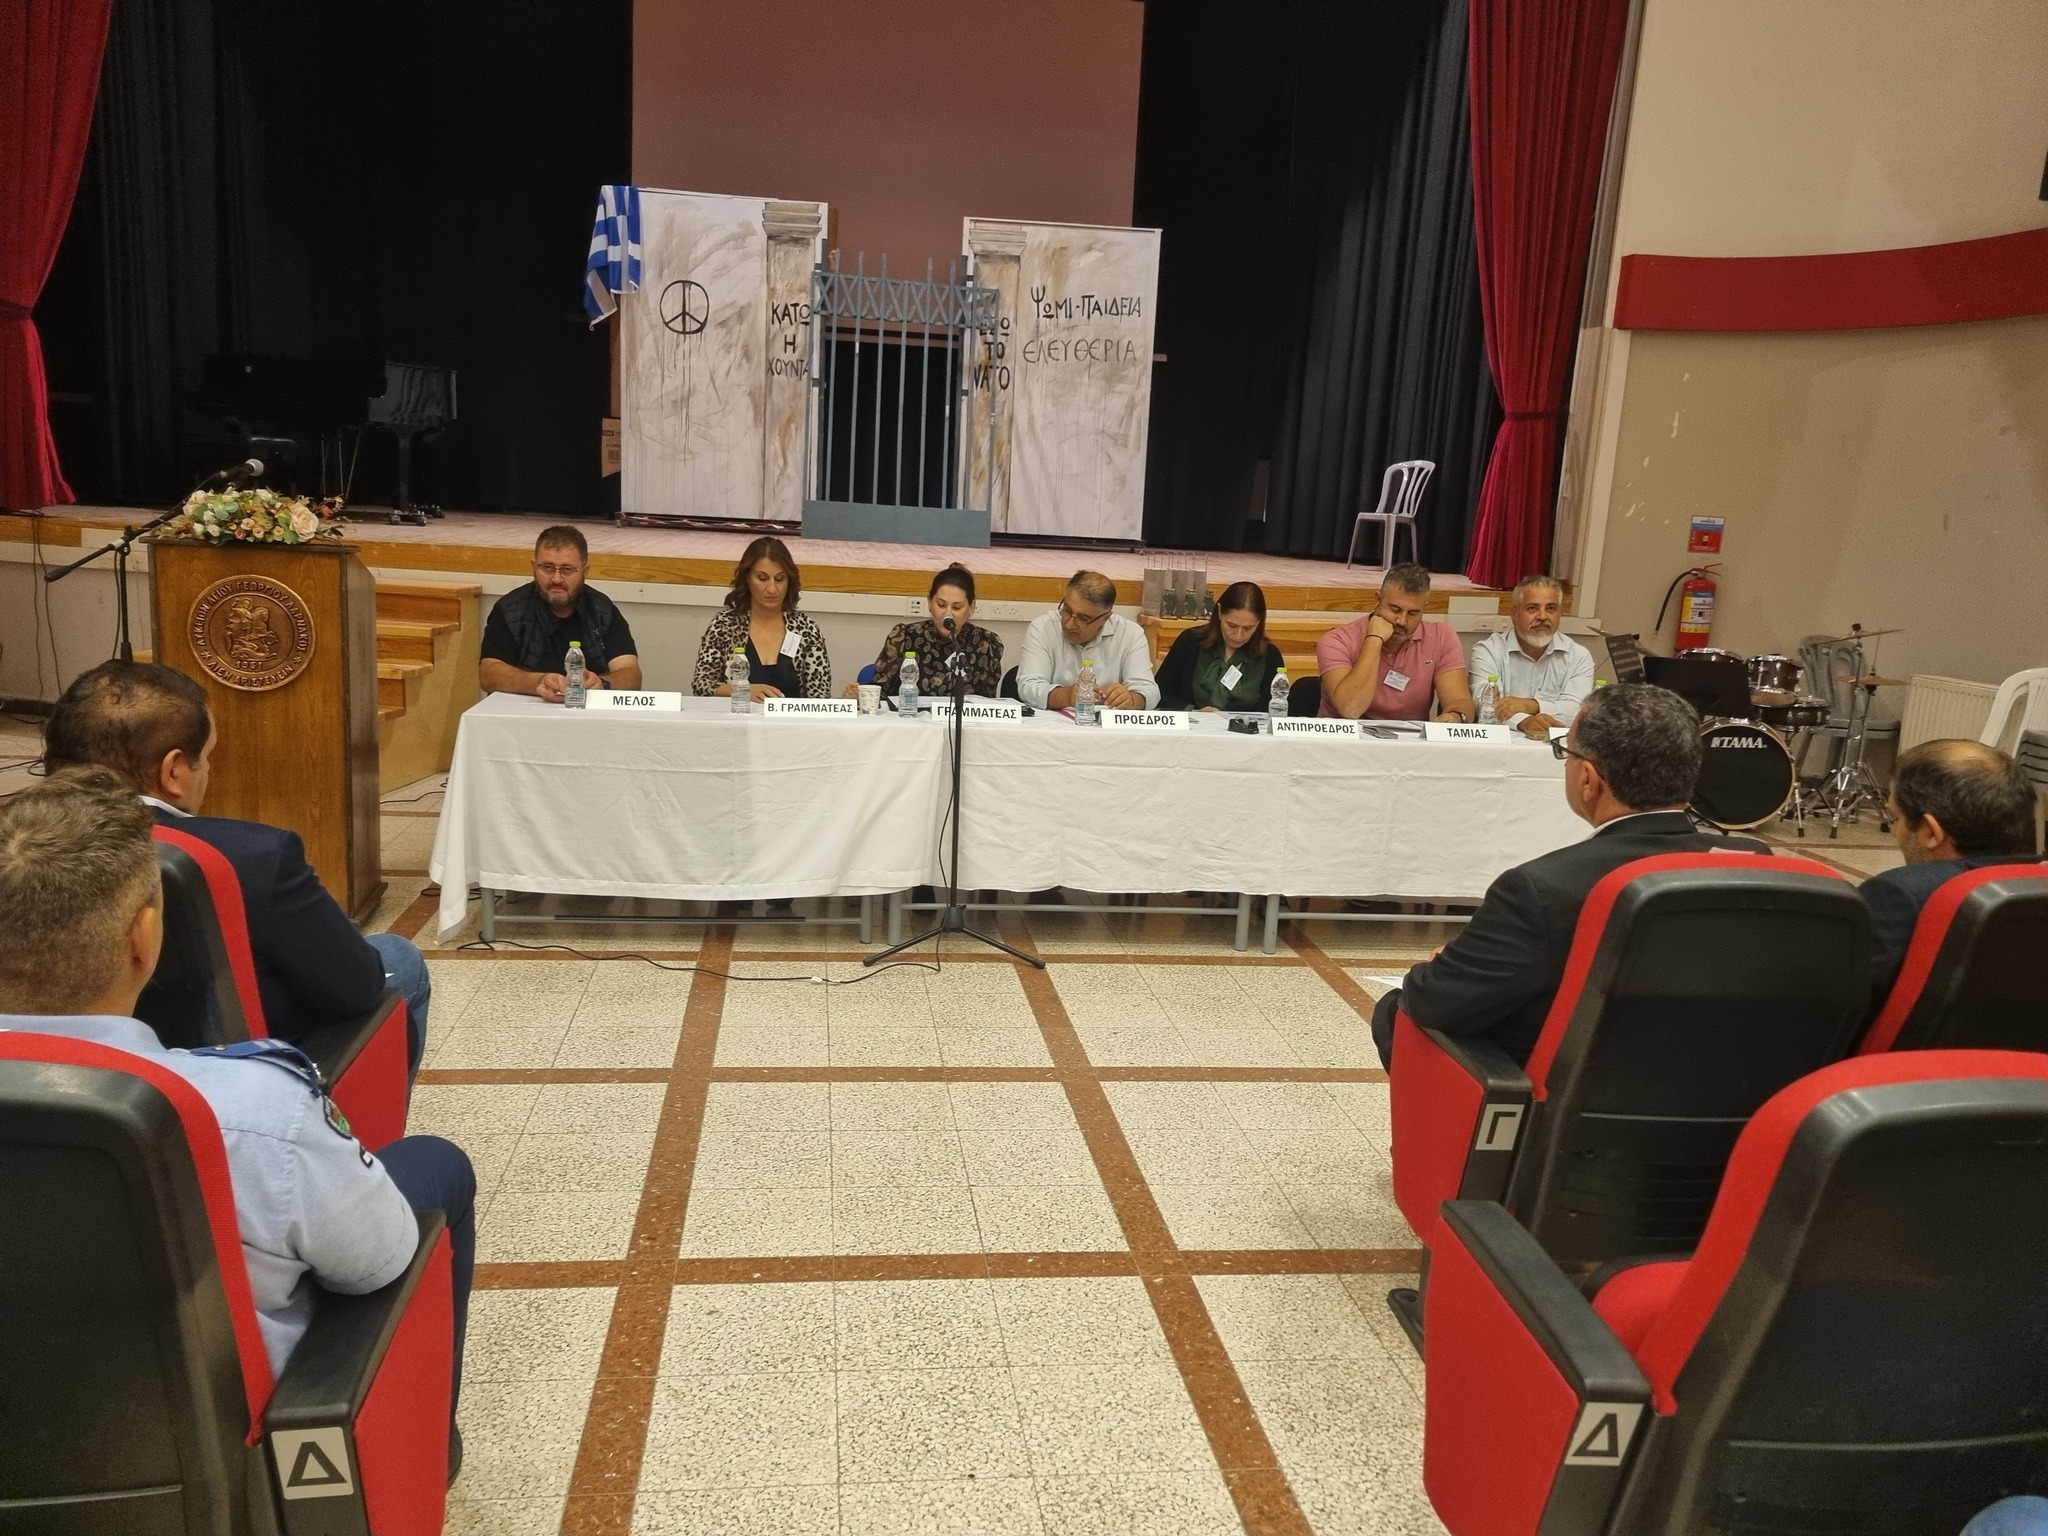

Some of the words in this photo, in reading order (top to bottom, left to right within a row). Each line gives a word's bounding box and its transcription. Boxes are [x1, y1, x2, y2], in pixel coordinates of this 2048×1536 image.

[771, 301, 811, 326] ΚΑΤΩ
[784, 334, 796, 354] Η
[984, 341, 1005, 361] ΤΟ
[1022, 338, 1137, 364] ΕΛΕΥΘΕΡΙΑ
[236, 581, 288, 602] ΓΕΩΡΓΙΟΥ
[612, 695, 656, 707] ΜΕΛΟΣ
[767, 702, 778, 713] Β.
[781, 702, 853, 714] ΓΡΑΜΜΑΤΕΑΣ
[1114, 714, 1176, 726] ΠΡΟΕΔΡΟΣ
[1277, 721, 1356, 734] ΑΝΤΙΠΡΟΕΔΡΟΣ
[1447, 727, 1489, 739] ΤΑΜΙΑΣ
[1720, 736, 1763, 749] TAMA
[1486, 1111, 1517, 1144] Γ
[1572, 1413, 1619, 1458] Δ
[286, 1441, 348, 1488] Δ
